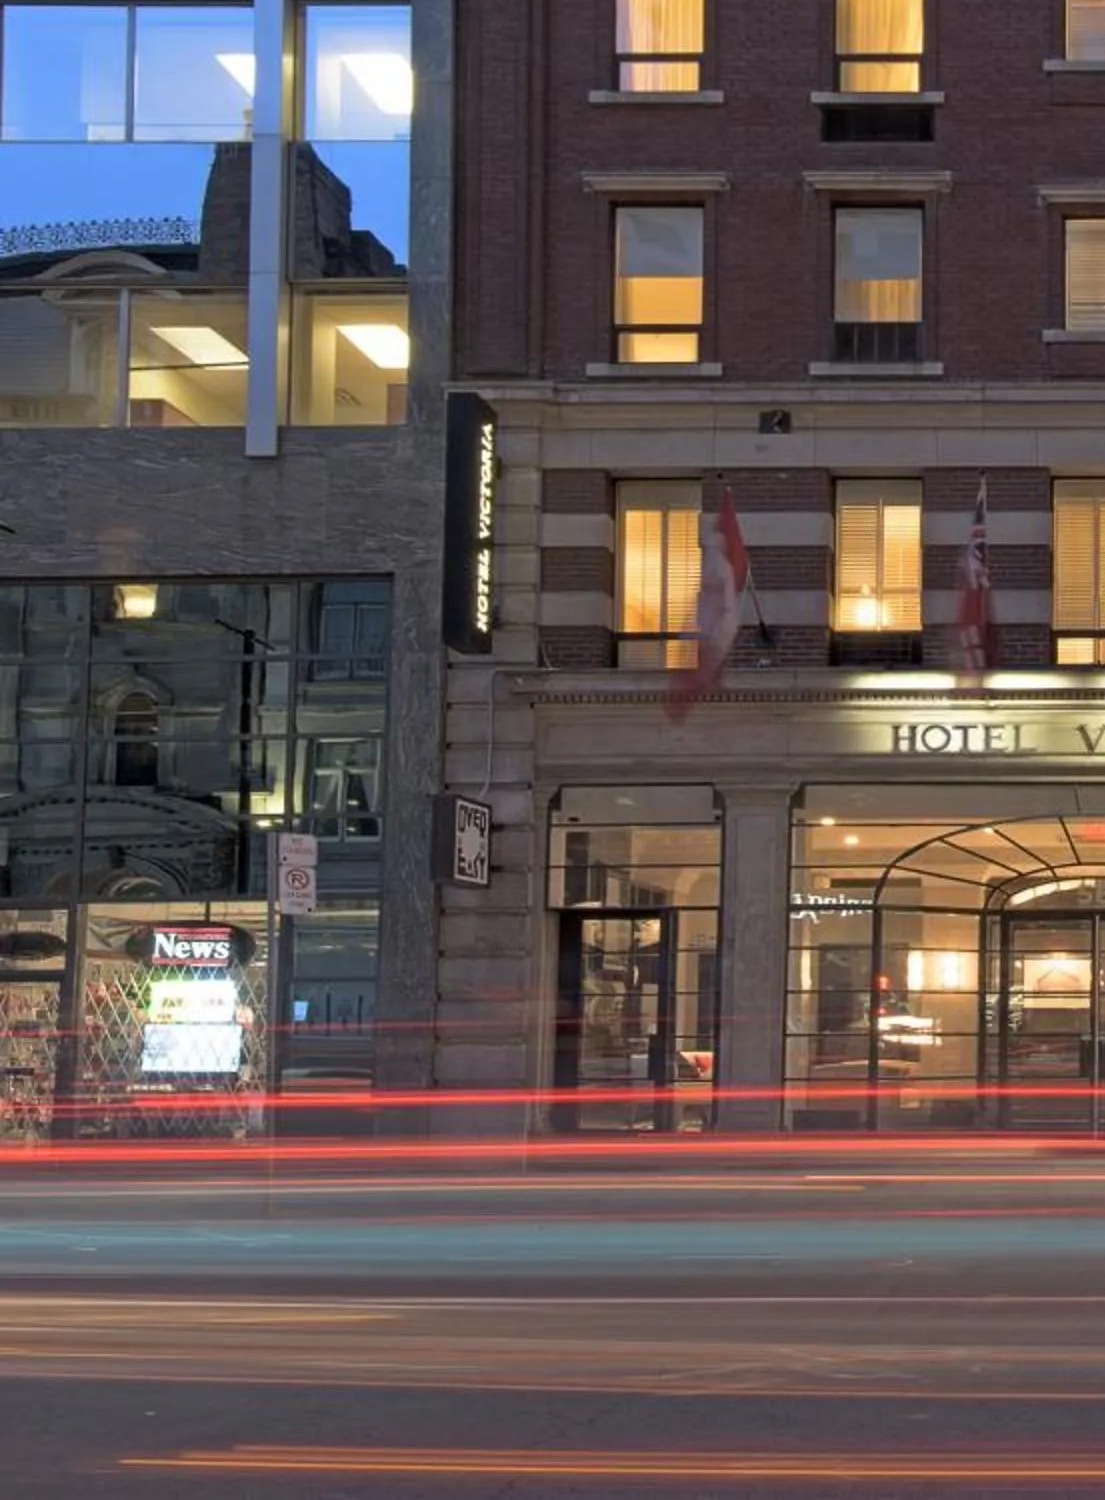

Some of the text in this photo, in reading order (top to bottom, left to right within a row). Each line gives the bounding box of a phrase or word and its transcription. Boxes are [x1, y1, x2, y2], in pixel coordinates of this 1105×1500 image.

[476, 423, 494, 633] HOTEL VICTORIA
[891, 723, 1038, 753] HOTEL
[154, 933, 230, 959] News
